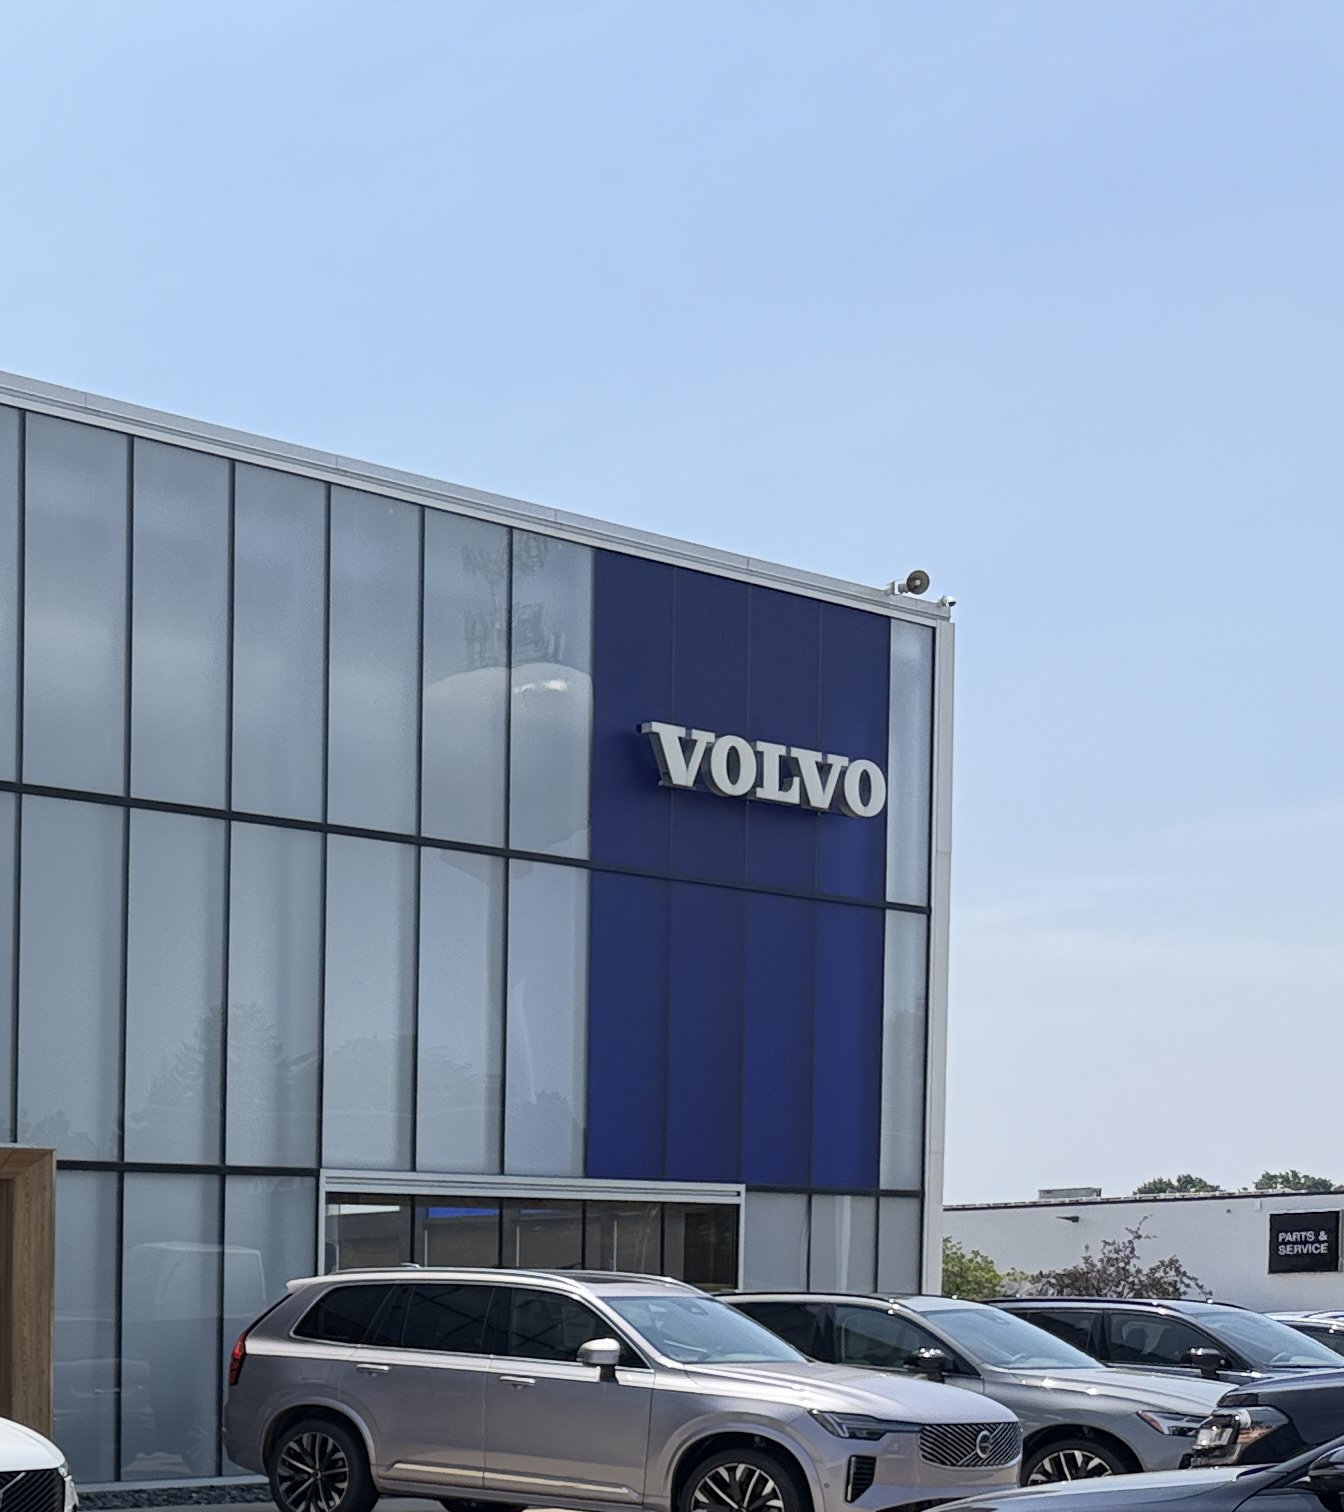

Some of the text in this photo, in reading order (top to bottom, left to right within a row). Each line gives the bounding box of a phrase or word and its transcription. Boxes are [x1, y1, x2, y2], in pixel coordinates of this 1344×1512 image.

[640, 721, 887, 818] VOLVO
[1278, 1230, 1328, 1243] PARTS &
[1278, 1243, 1329, 1255] SERVICE
